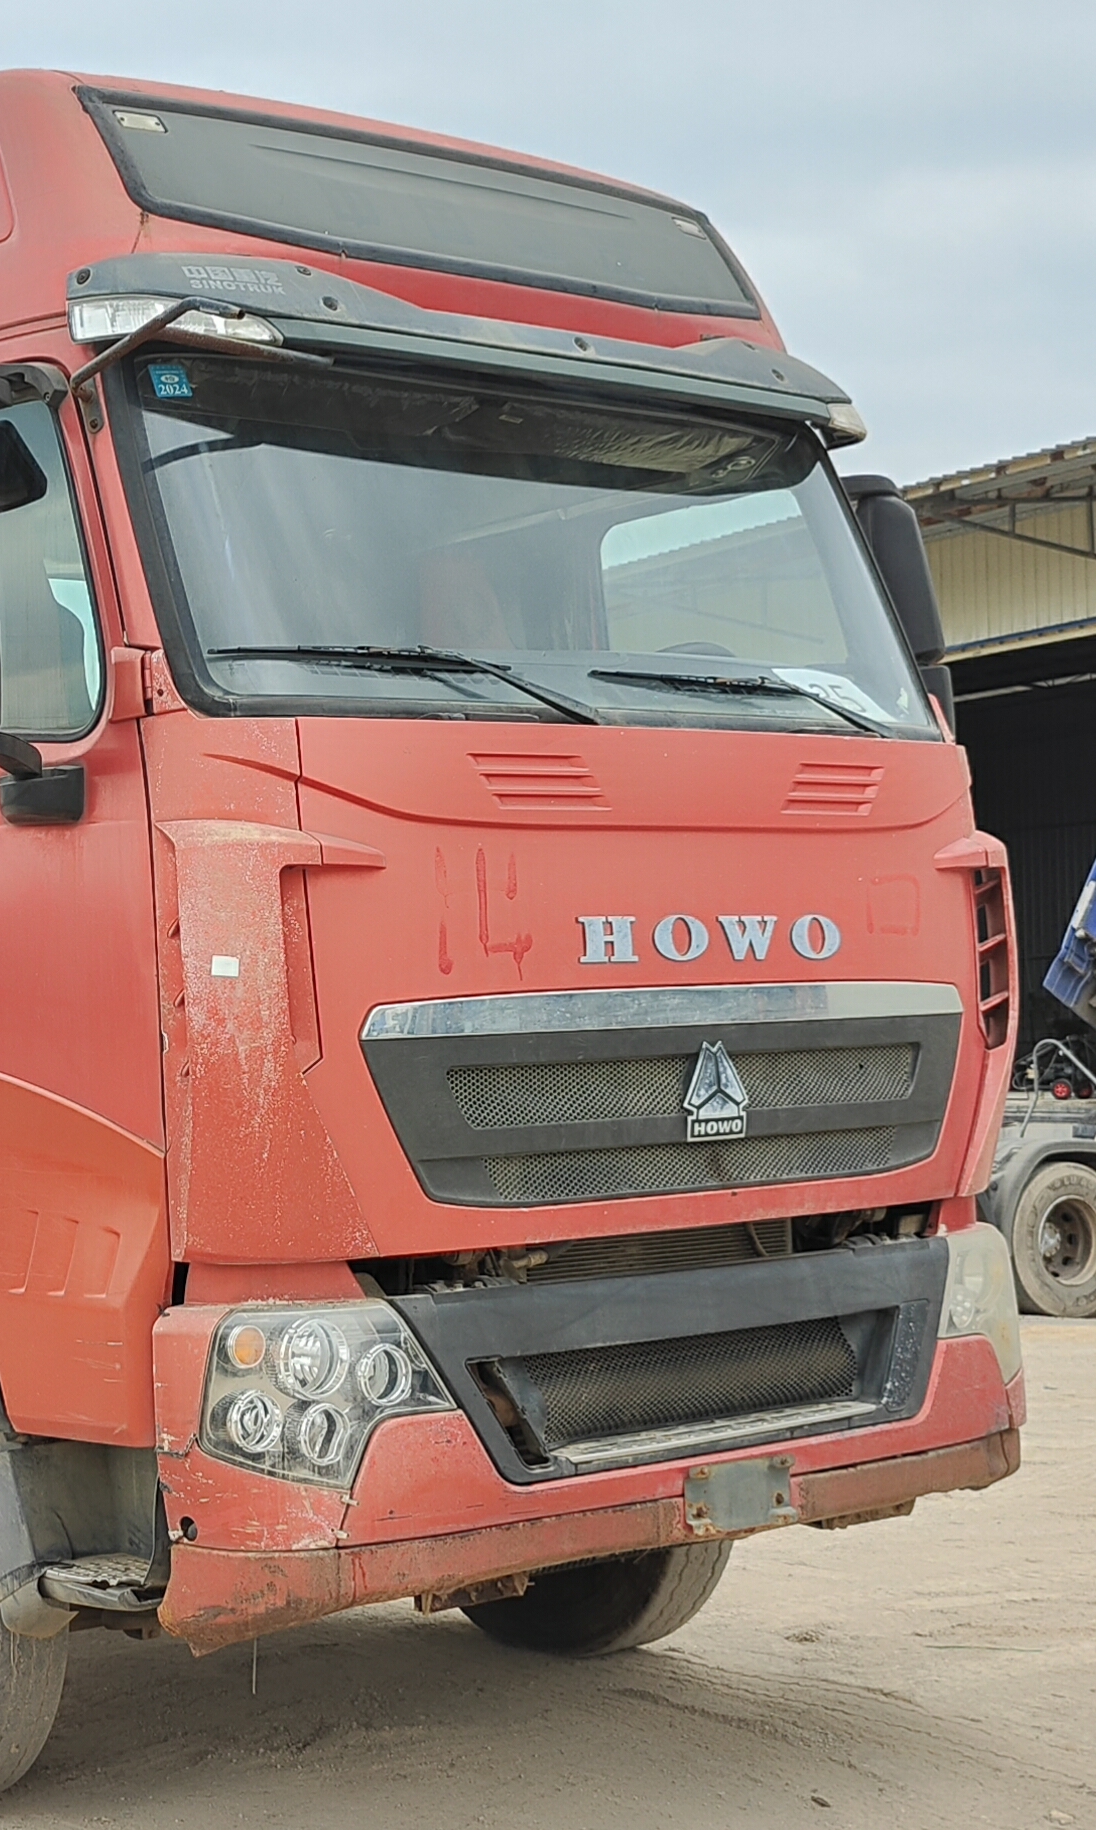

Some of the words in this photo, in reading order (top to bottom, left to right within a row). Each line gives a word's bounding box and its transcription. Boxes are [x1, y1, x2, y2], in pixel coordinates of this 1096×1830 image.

[189, 280, 286, 296] SINOTRUK
[158, 383, 188, 395] 2024
[576, 914, 842, 964] HOWO
[693, 1118, 743, 1136] HOWO
